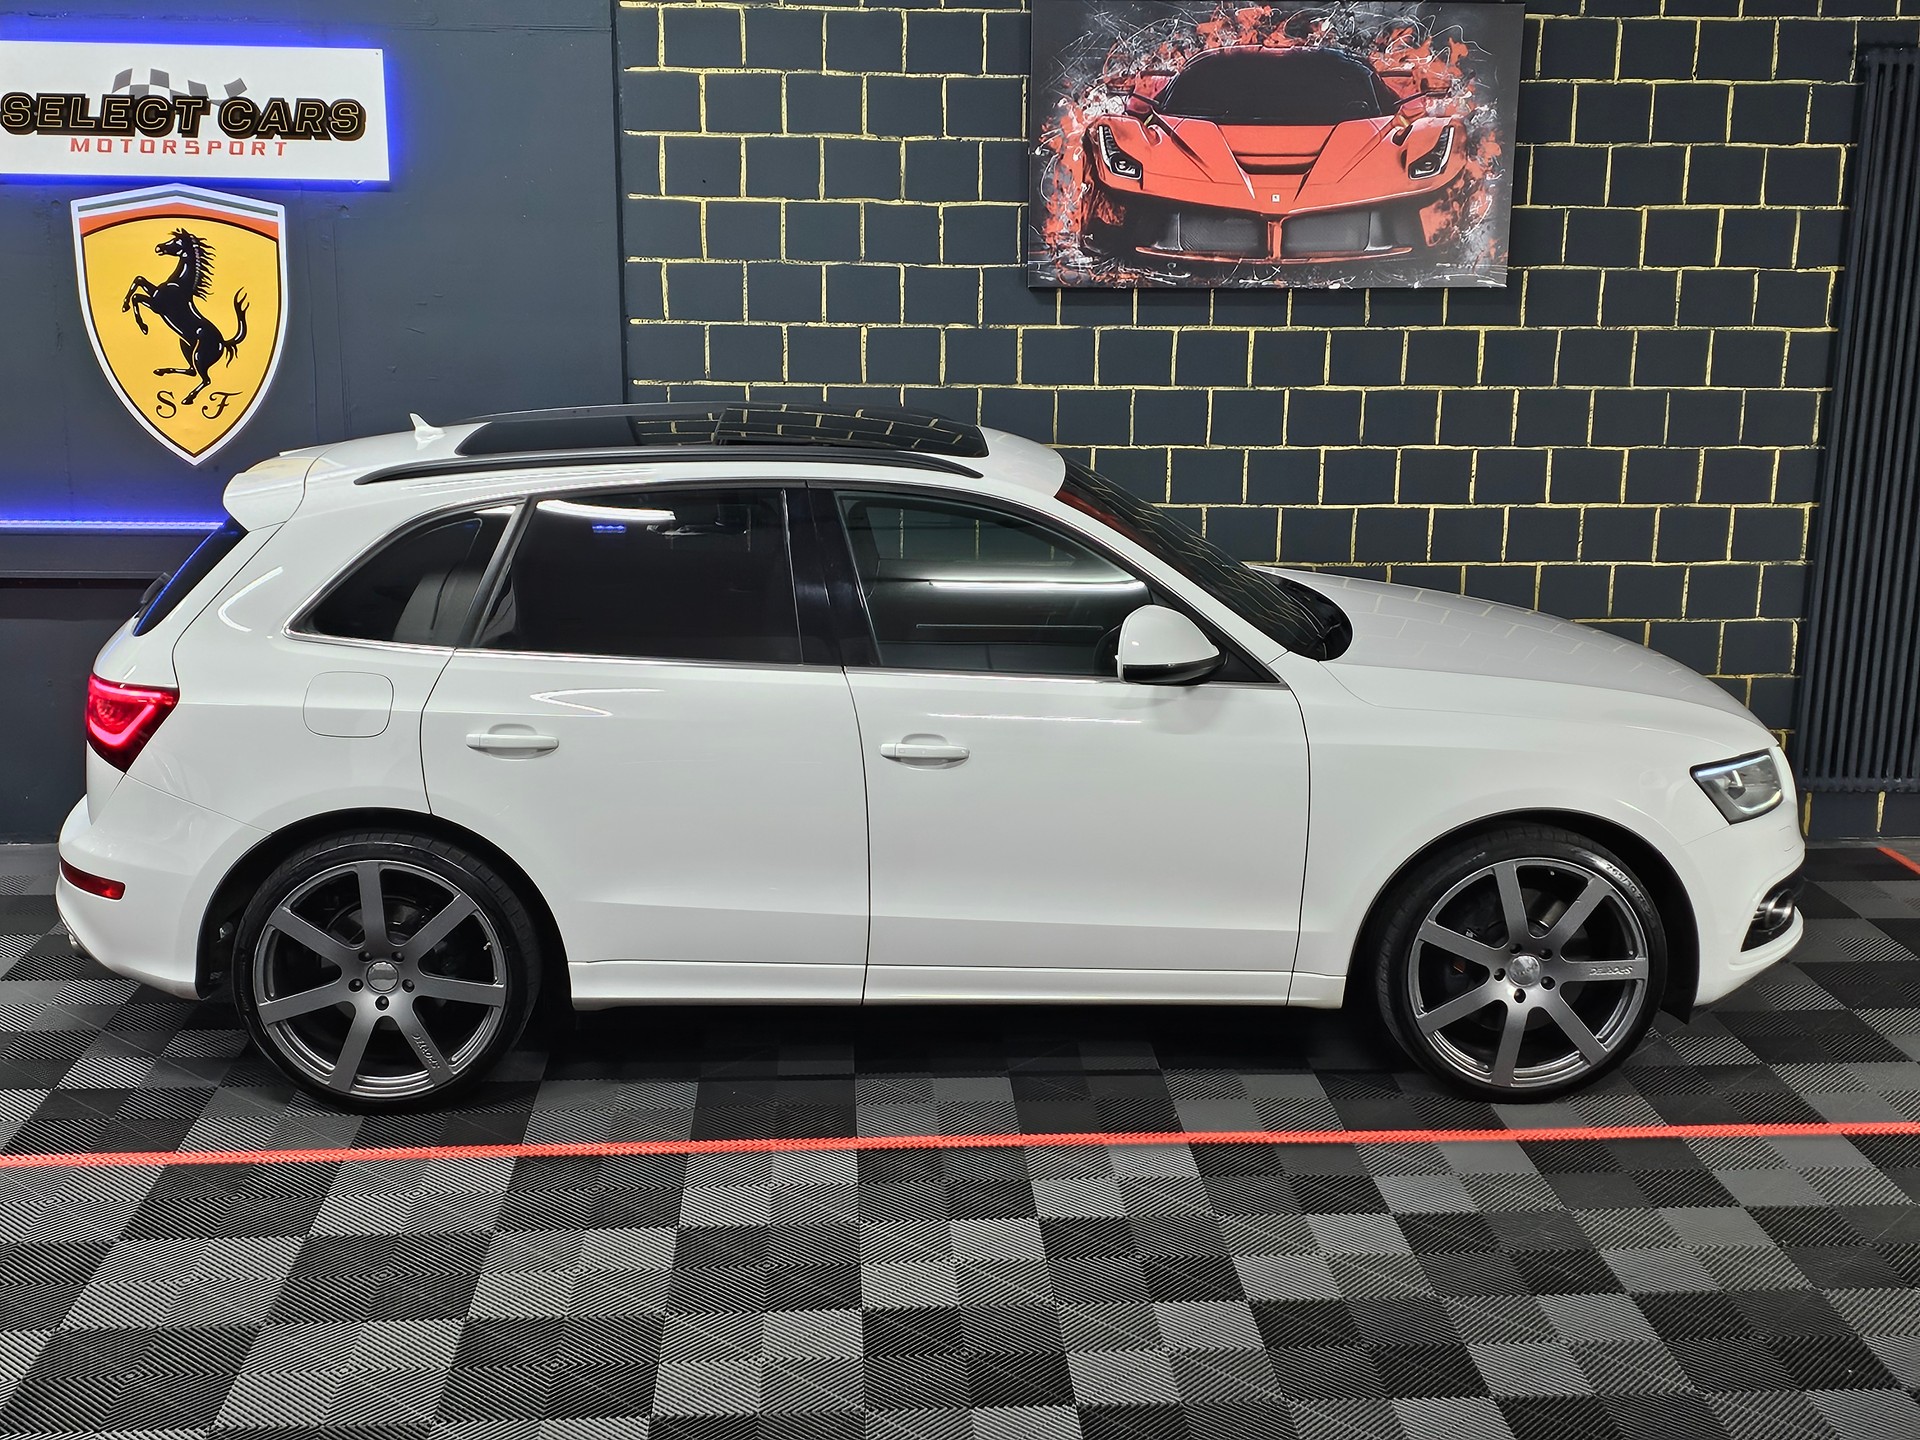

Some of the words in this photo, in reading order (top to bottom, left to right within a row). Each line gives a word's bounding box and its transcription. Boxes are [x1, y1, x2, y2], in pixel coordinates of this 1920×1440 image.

[0, 92, 211, 137] SELECT
[217, 97, 366, 141] CARS
[70, 138, 288, 156] MOTORSPORT
[155, 390, 177, 419] S
[201, 391, 243, 420] F
